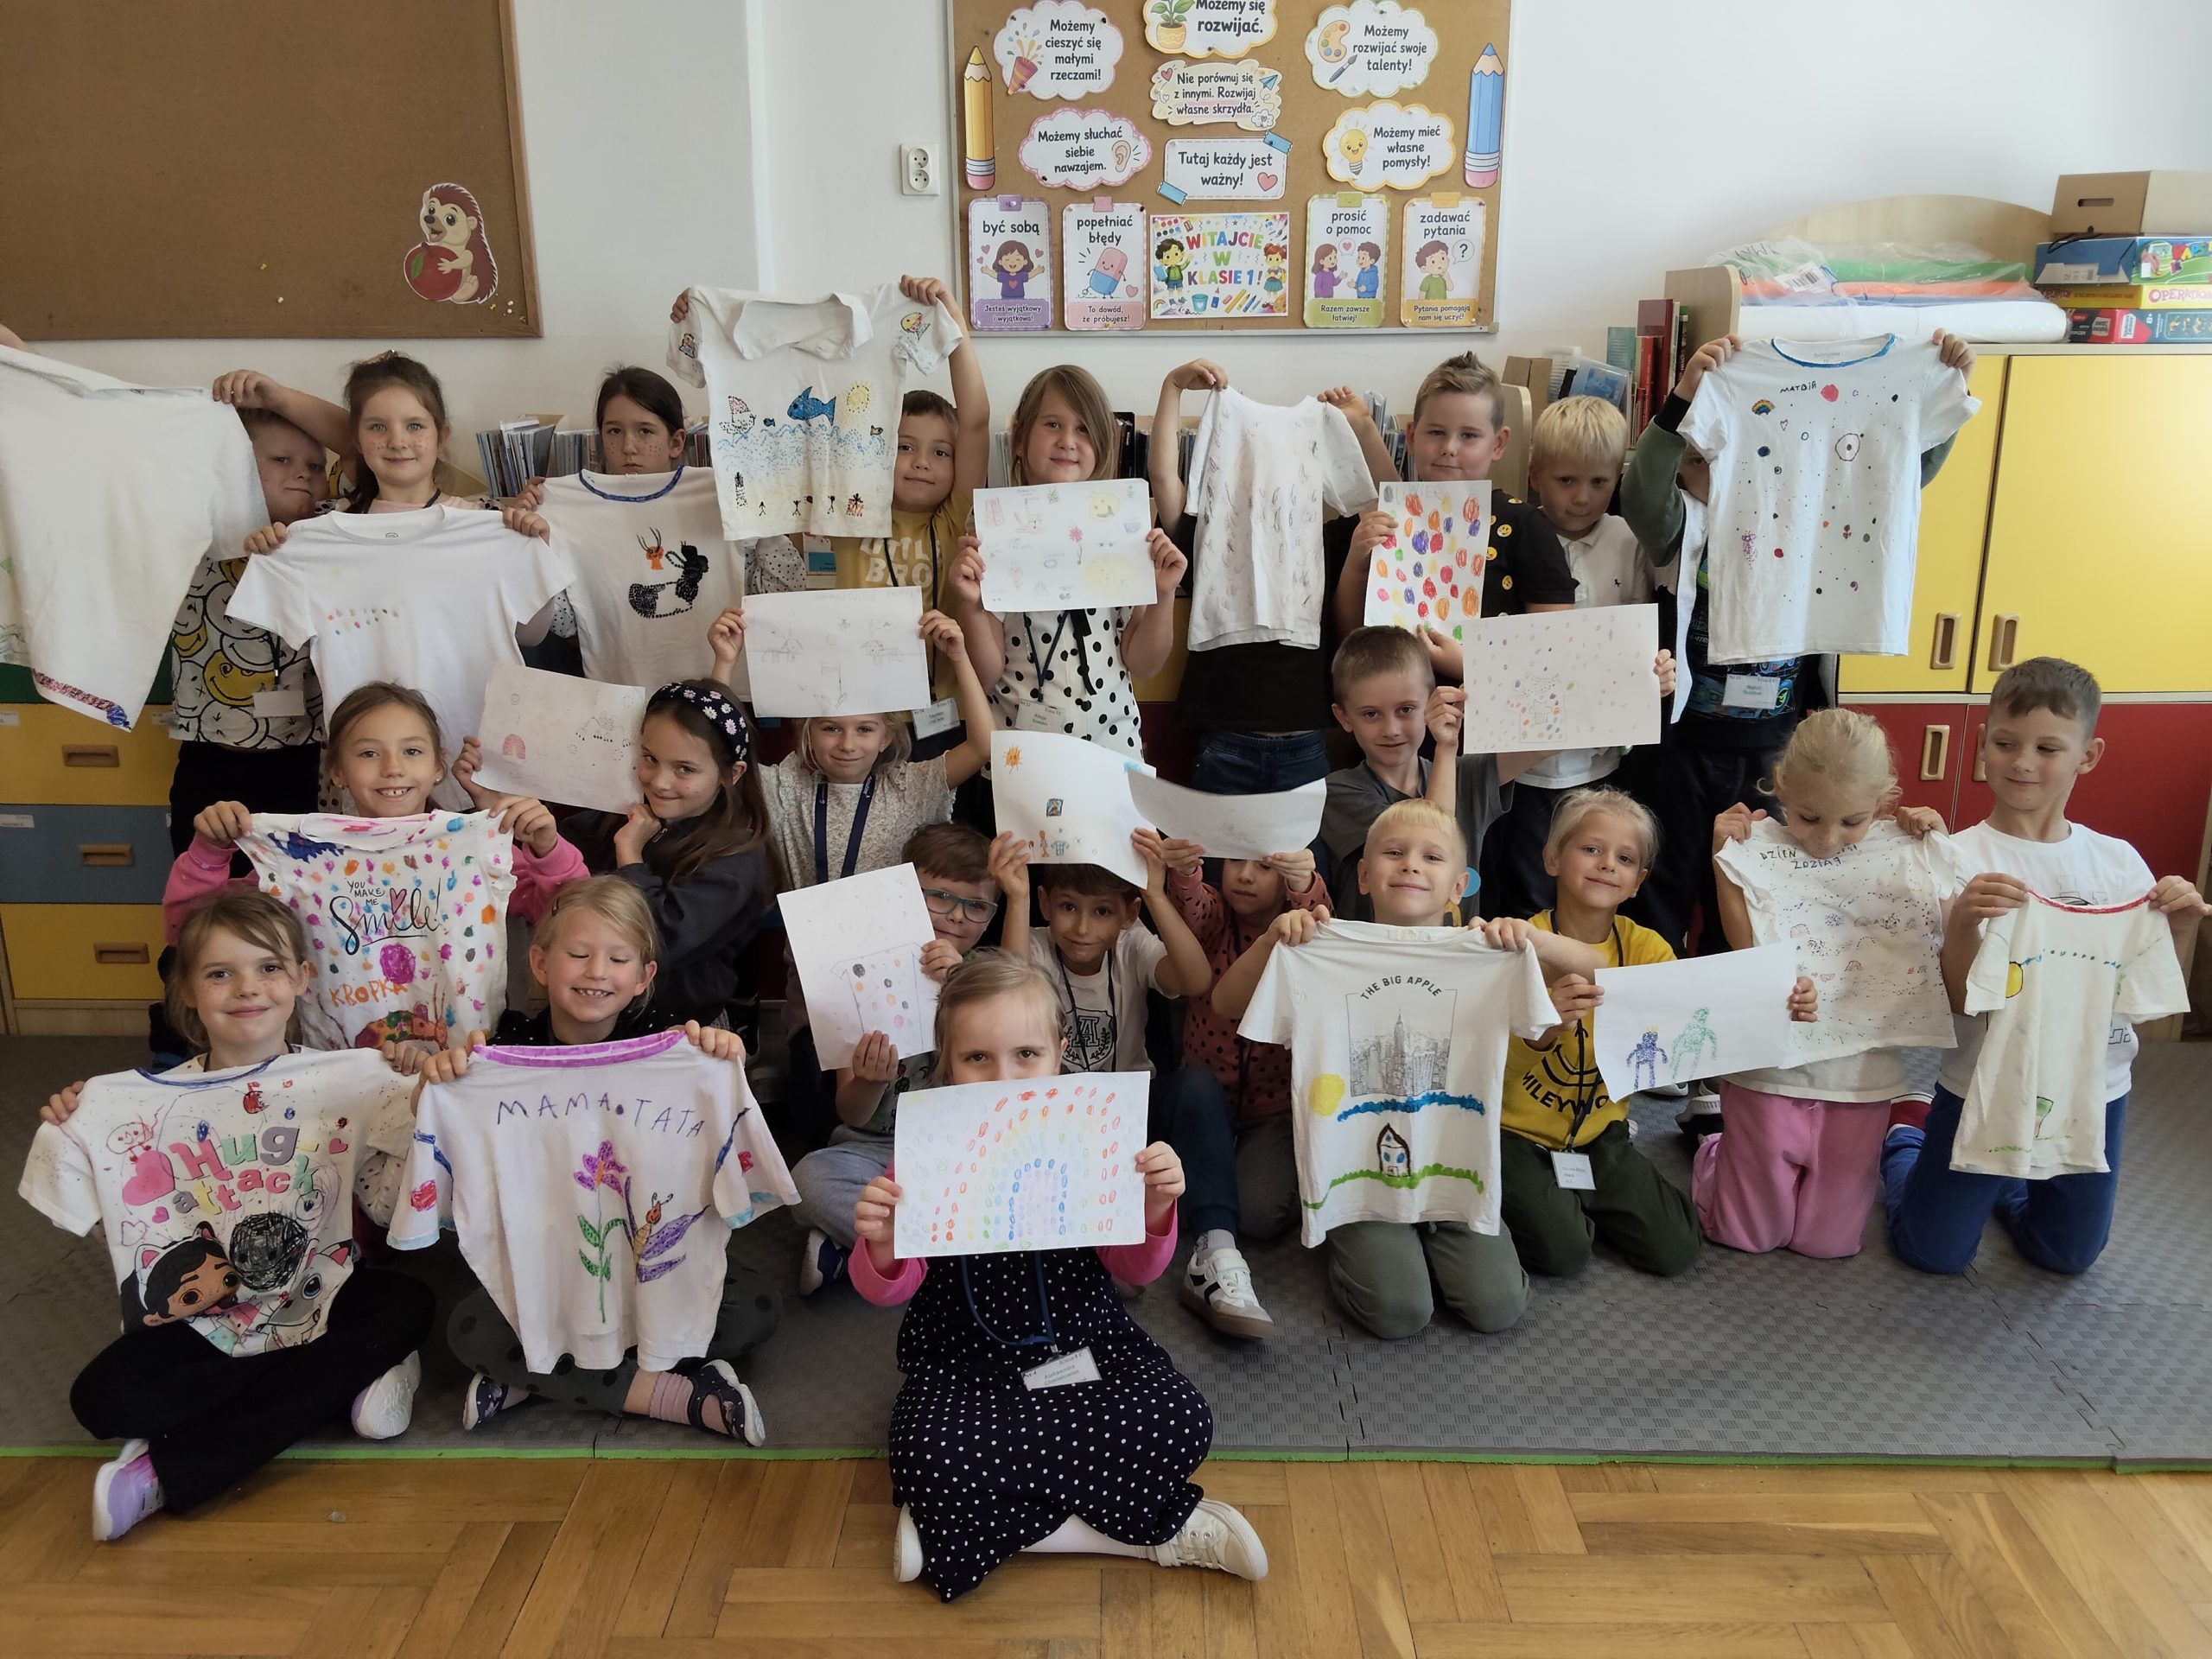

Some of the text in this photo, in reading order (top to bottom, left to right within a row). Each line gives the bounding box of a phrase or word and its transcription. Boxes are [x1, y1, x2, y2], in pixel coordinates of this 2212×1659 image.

[1050, 19, 1096, 35] Możemy
[1198, 17, 1264, 37] rozwijać.
[1363, 25, 1409, 39] Możemy
[1045, 36, 1102, 50] cieszyć się
[1352, 41, 1427, 56] rozwijać swoje
[1054, 53, 1094, 67] małymi
[1367, 59, 1412, 74] talenty!
[1050, 68, 1102, 81] rzeczami!
[1177, 73, 1253, 86] Nie porównuj się
[1182, 89, 1214, 101] innymi.
[1217, 86, 1256, 100] Rozwijaj
[1176, 102, 1255, 118] własne skrzydła.
[1038, 125, 1123, 145] Możemy słuchać
[1373, 125, 1441, 141] Możemy mieć
[1065, 146, 1095, 158] siebie
[1387, 143, 1425, 154] własne
[1178, 151, 1273, 169] Tutaj każdy jest
[1382, 155, 1431, 170] pomysły!
[1053, 162, 1107, 175] nawzajem.
[1200, 173, 1244, 189] ważny!
[1077, 215, 1134, 230] popełniać
[1331, 210, 1368, 224] prosić
[1420, 212, 1471, 224] zadawać
[982, 219, 1040, 236] być sobą
[1336, 226, 1371, 238] pomoc
[1423, 225, 1466, 238] pytania
[1089, 231, 1122, 246] błędy
[1185, 231, 1264, 251] WITAJCIE
[1213, 251, 1232, 266] W
[1187, 269, 1243, 286] KLASIE
[1007, 305, 1042, 314] wyjątkowy
[1093, 315, 1130, 324] próbujesz!
[346, 880, 365, 893] YOU
[354, 887, 385, 897] MAKE
[1360, 976, 1442, 1000] THE BIG APPLE
[497, 1092, 705, 1138] MAMA TATA
